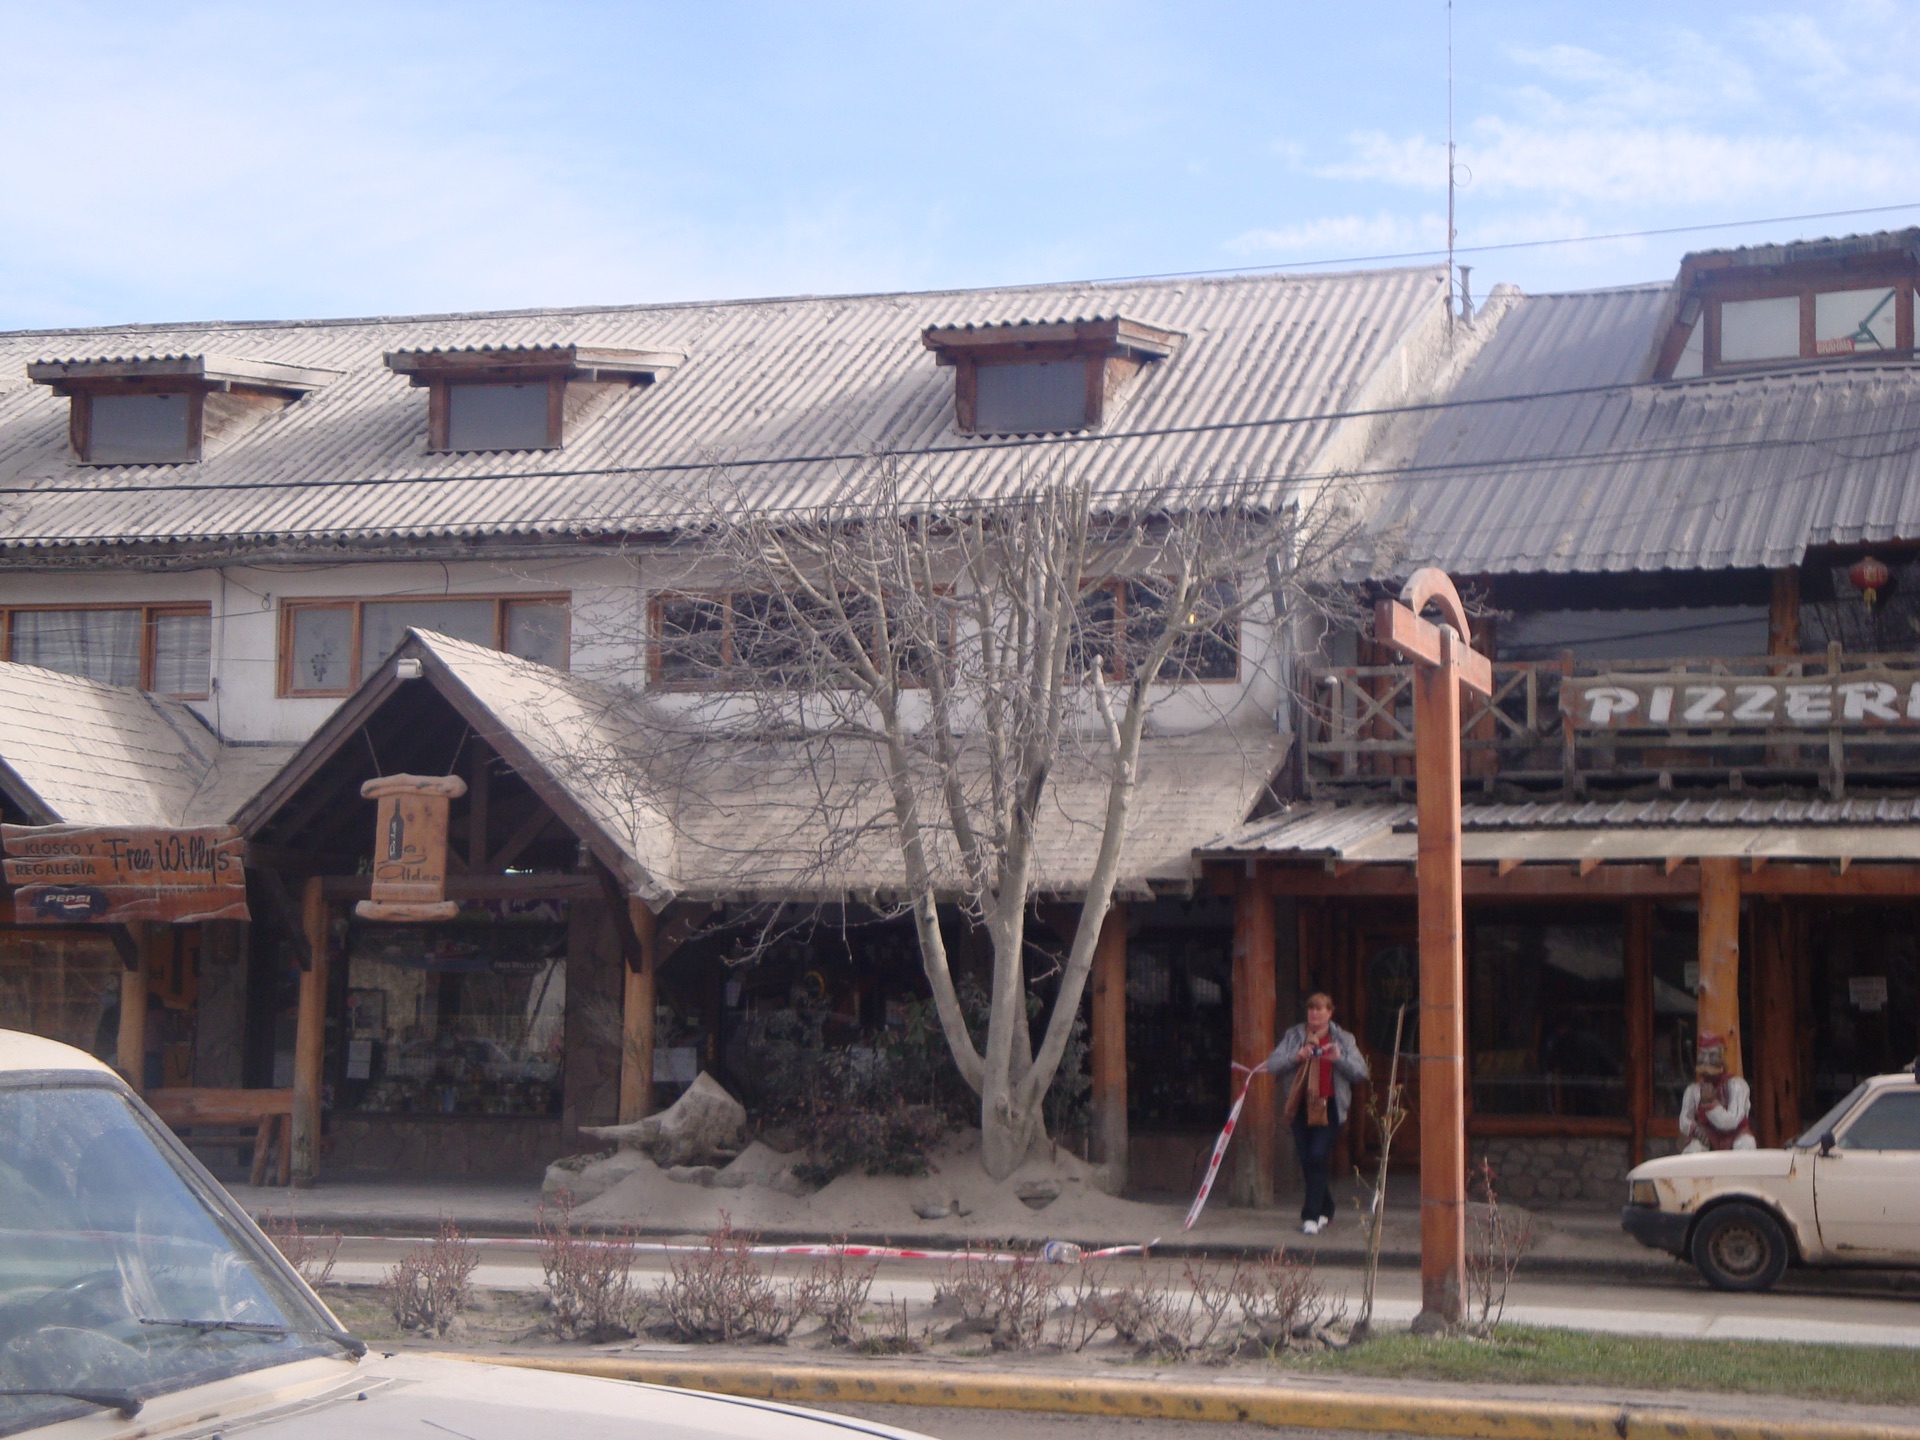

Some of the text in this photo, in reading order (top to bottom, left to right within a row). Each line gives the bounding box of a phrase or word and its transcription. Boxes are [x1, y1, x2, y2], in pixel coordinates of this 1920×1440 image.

[25, 842, 95, 855] KIOSCO Y
[102, 835, 230, 884] Free Willy's
[44, 894, 91, 903] PEPSI
